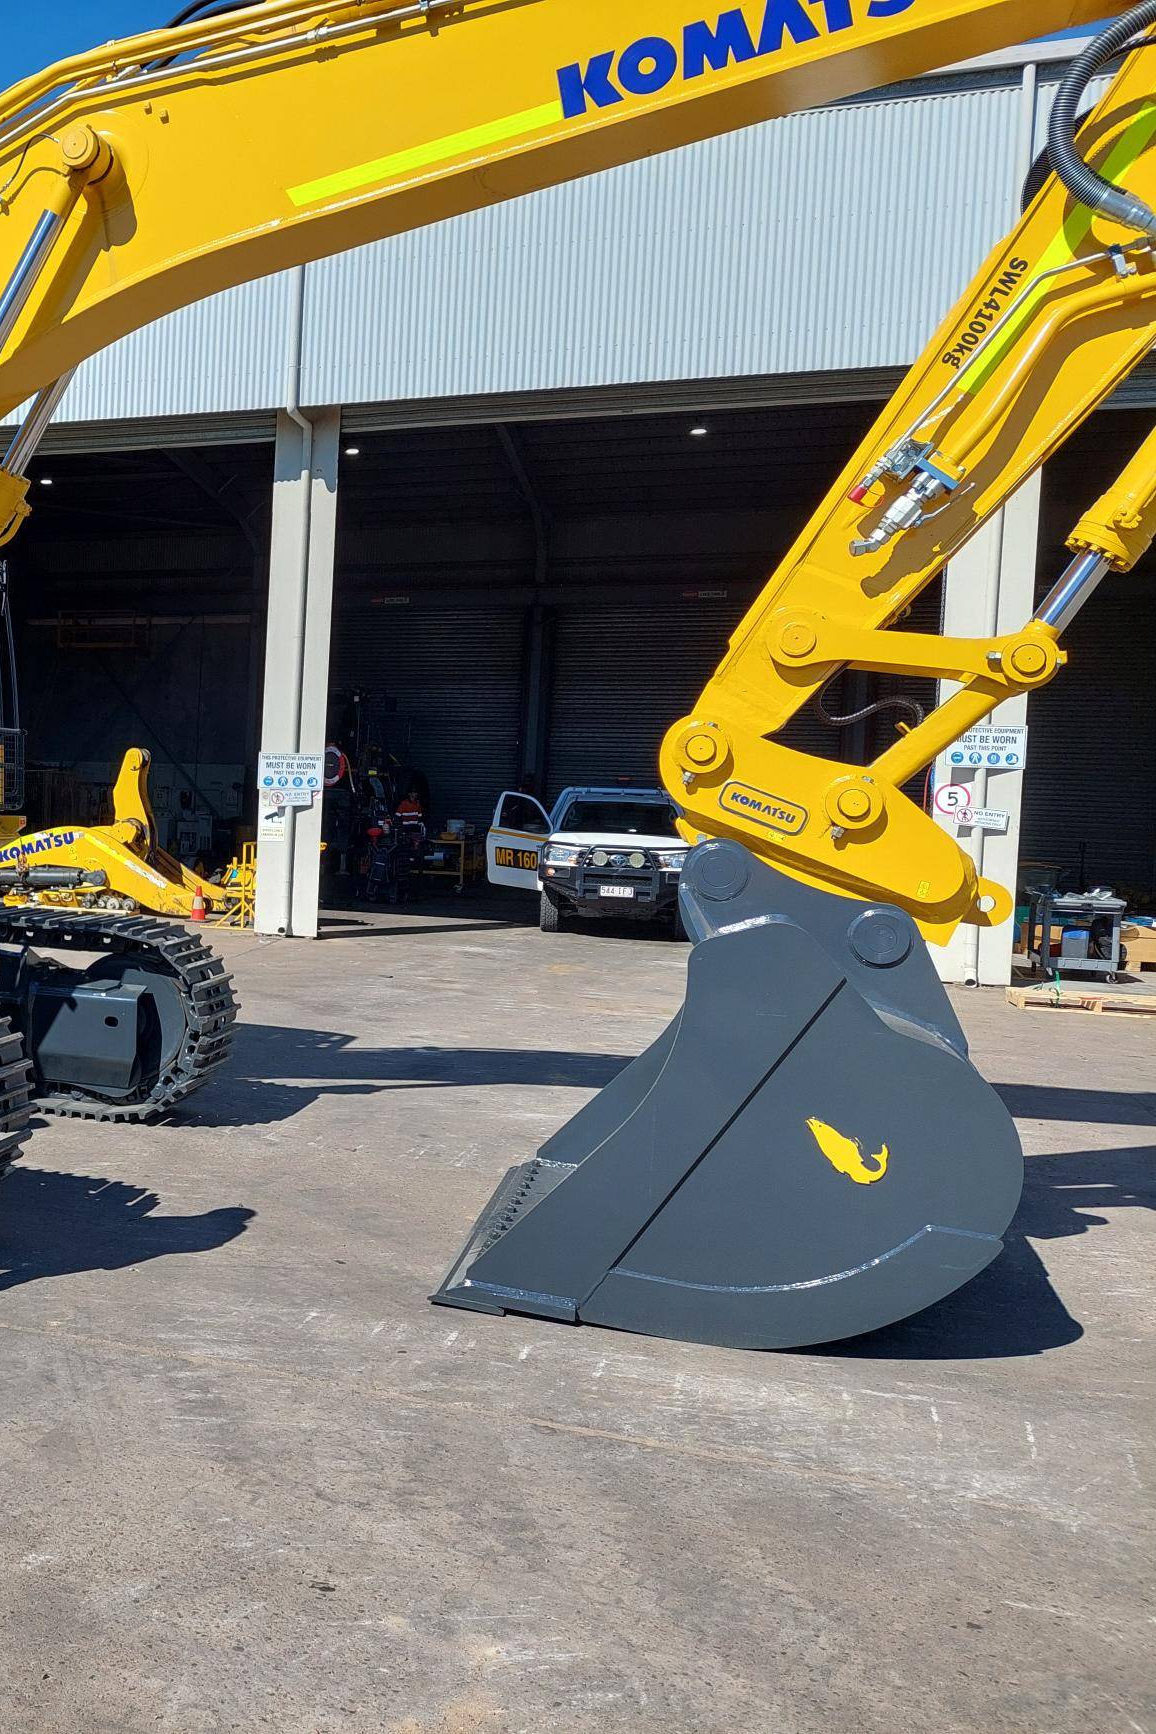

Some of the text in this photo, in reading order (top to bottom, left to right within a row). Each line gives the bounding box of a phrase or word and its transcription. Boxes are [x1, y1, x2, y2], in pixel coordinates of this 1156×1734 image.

[979, 735, 990, 743] BE
[992, 736, 1018, 744] WORN
[731, 791, 796, 824] KOMATSU
[947, 791, 959, 806] 5
[496, 847, 537, 869] MR 160
